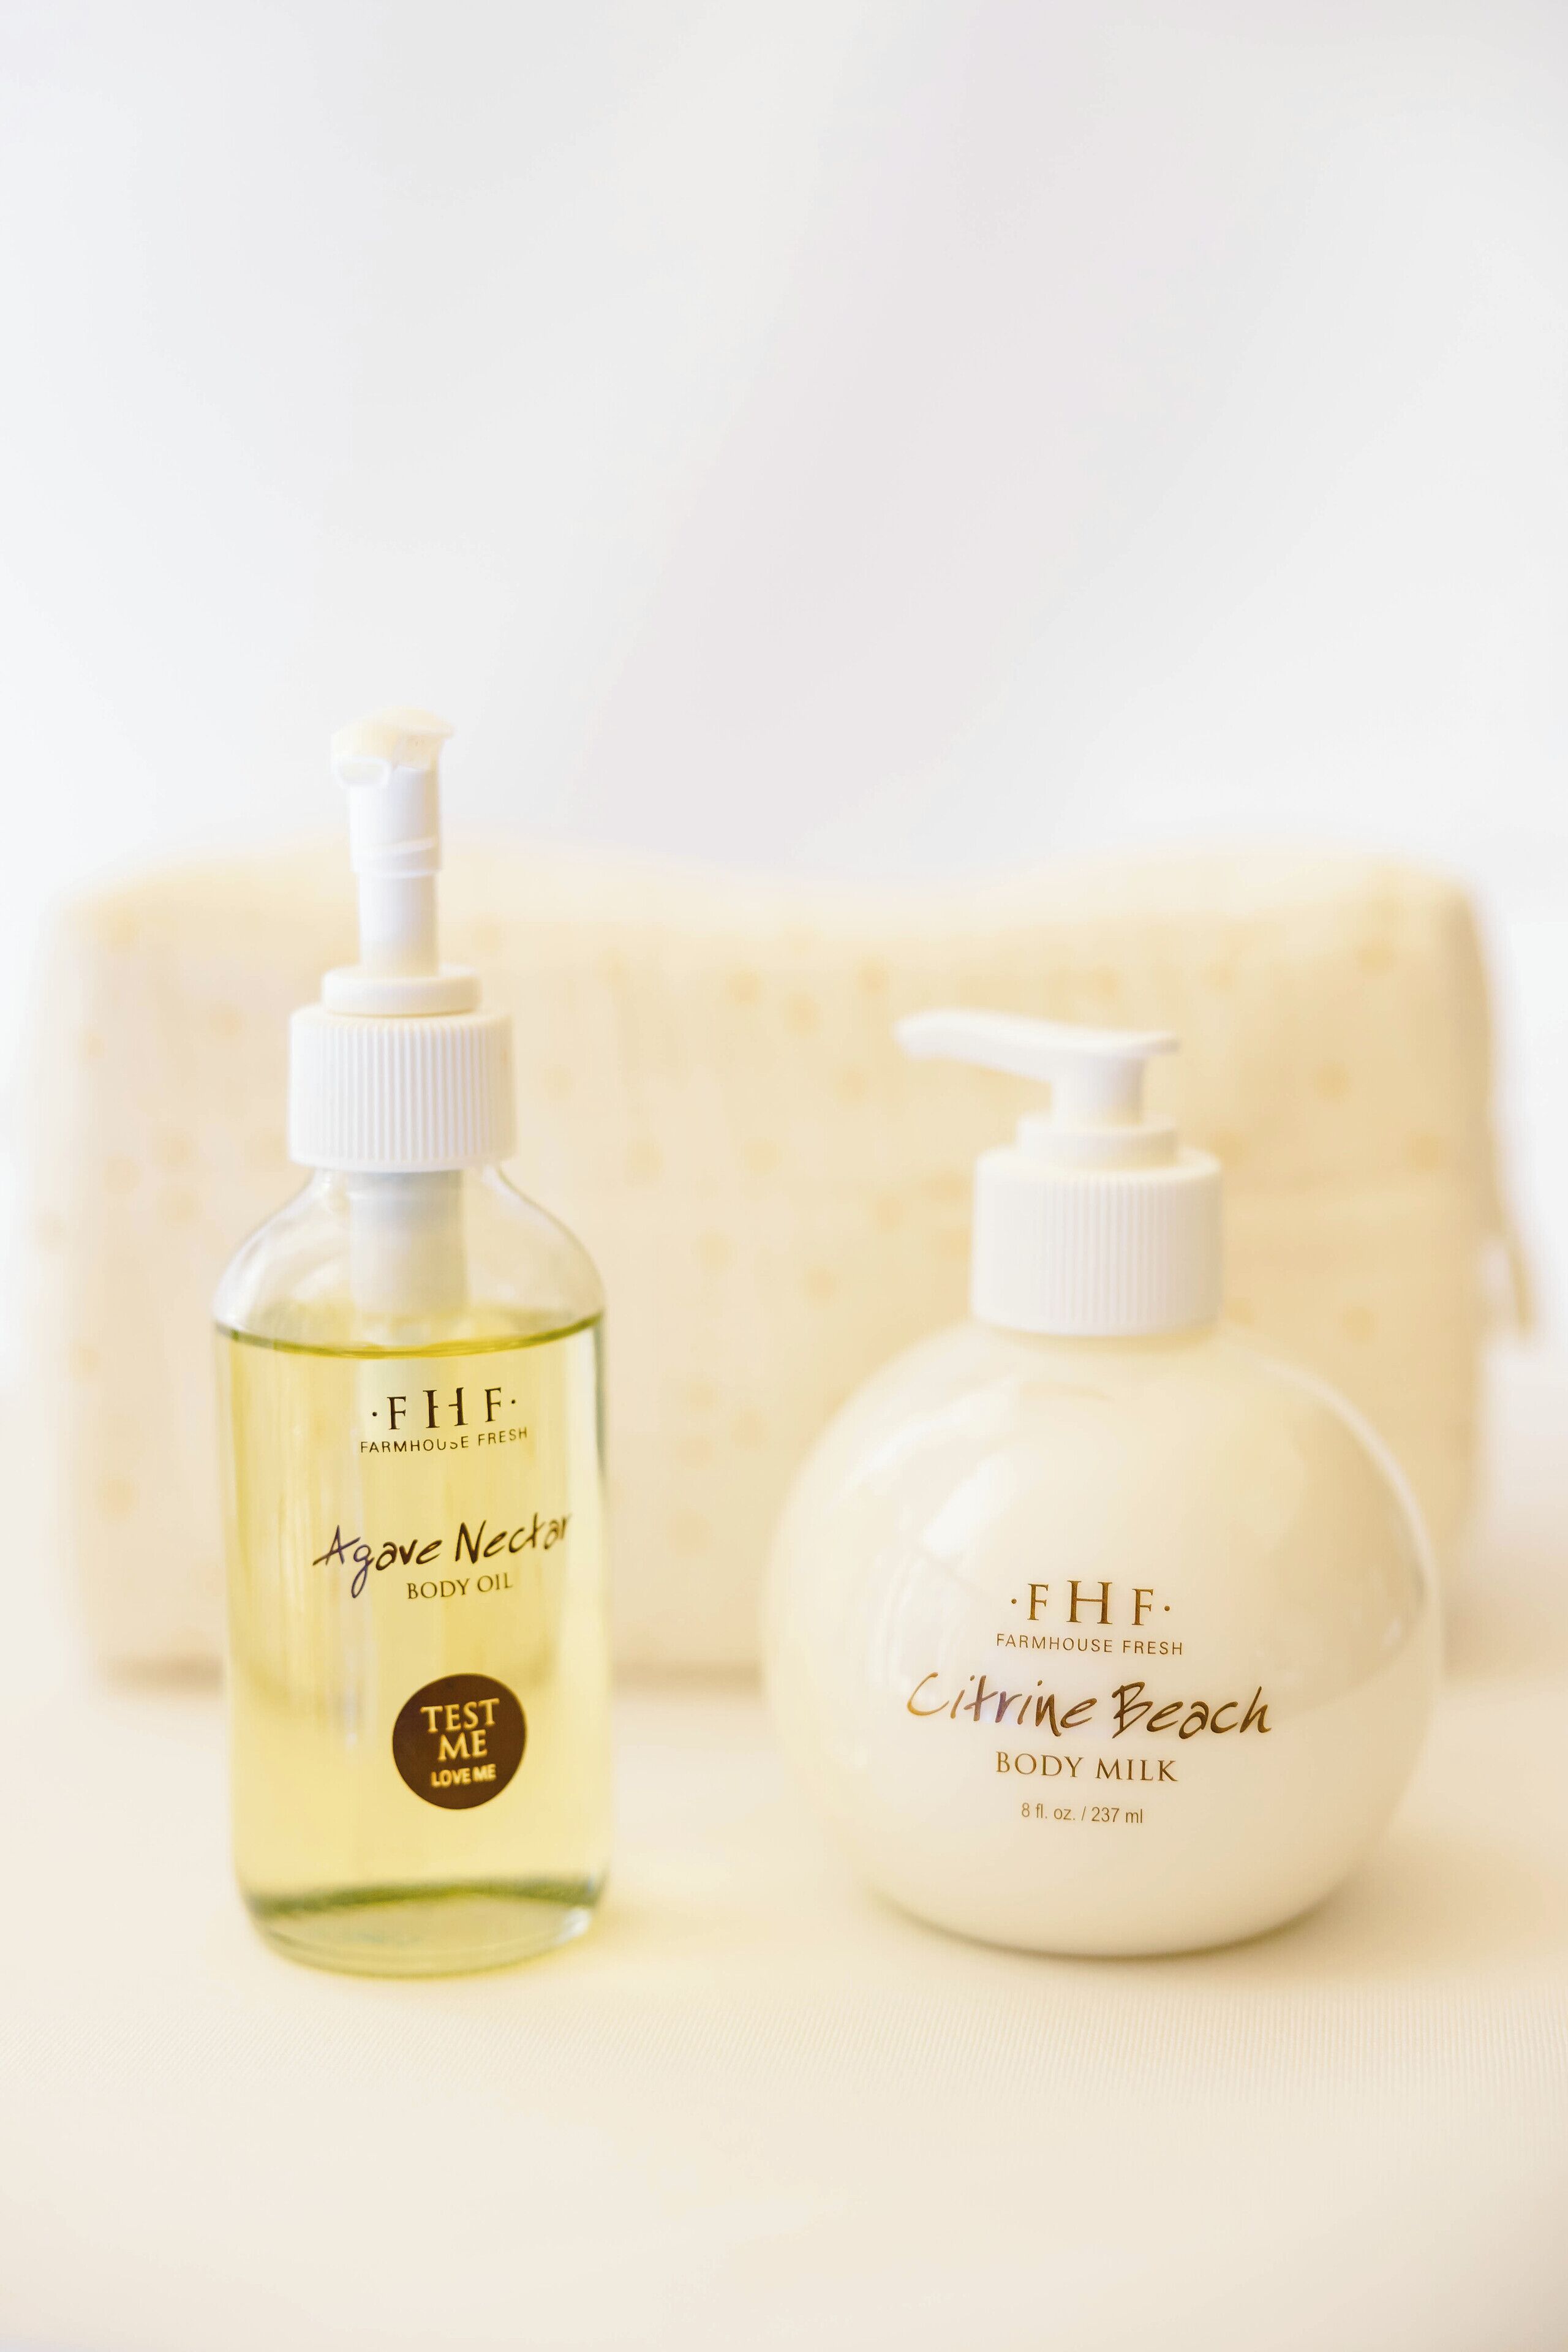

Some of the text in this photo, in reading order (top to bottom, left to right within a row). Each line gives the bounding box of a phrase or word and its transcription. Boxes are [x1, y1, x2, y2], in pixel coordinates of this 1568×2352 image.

[360, 1427, 527, 1453] FARMHOUSE FRESH
[312, 1512, 572, 1599] Agave Nectar
[407, 1572, 513, 1600] BODY OIL
[996, 1633, 1183, 1656] FARMHOUSE FRESH
[420, 1697, 500, 1733] TEST
[907, 1672, 1272, 1740] Citrine Beach
[437, 1729, 489, 1762] ME
[431, 1763, 497, 1787] LOVE ME
[995, 1751, 1178, 1782] BODY MILK
[1021, 1803, 1144, 1824] 8 fl. oz. / 237 ml
